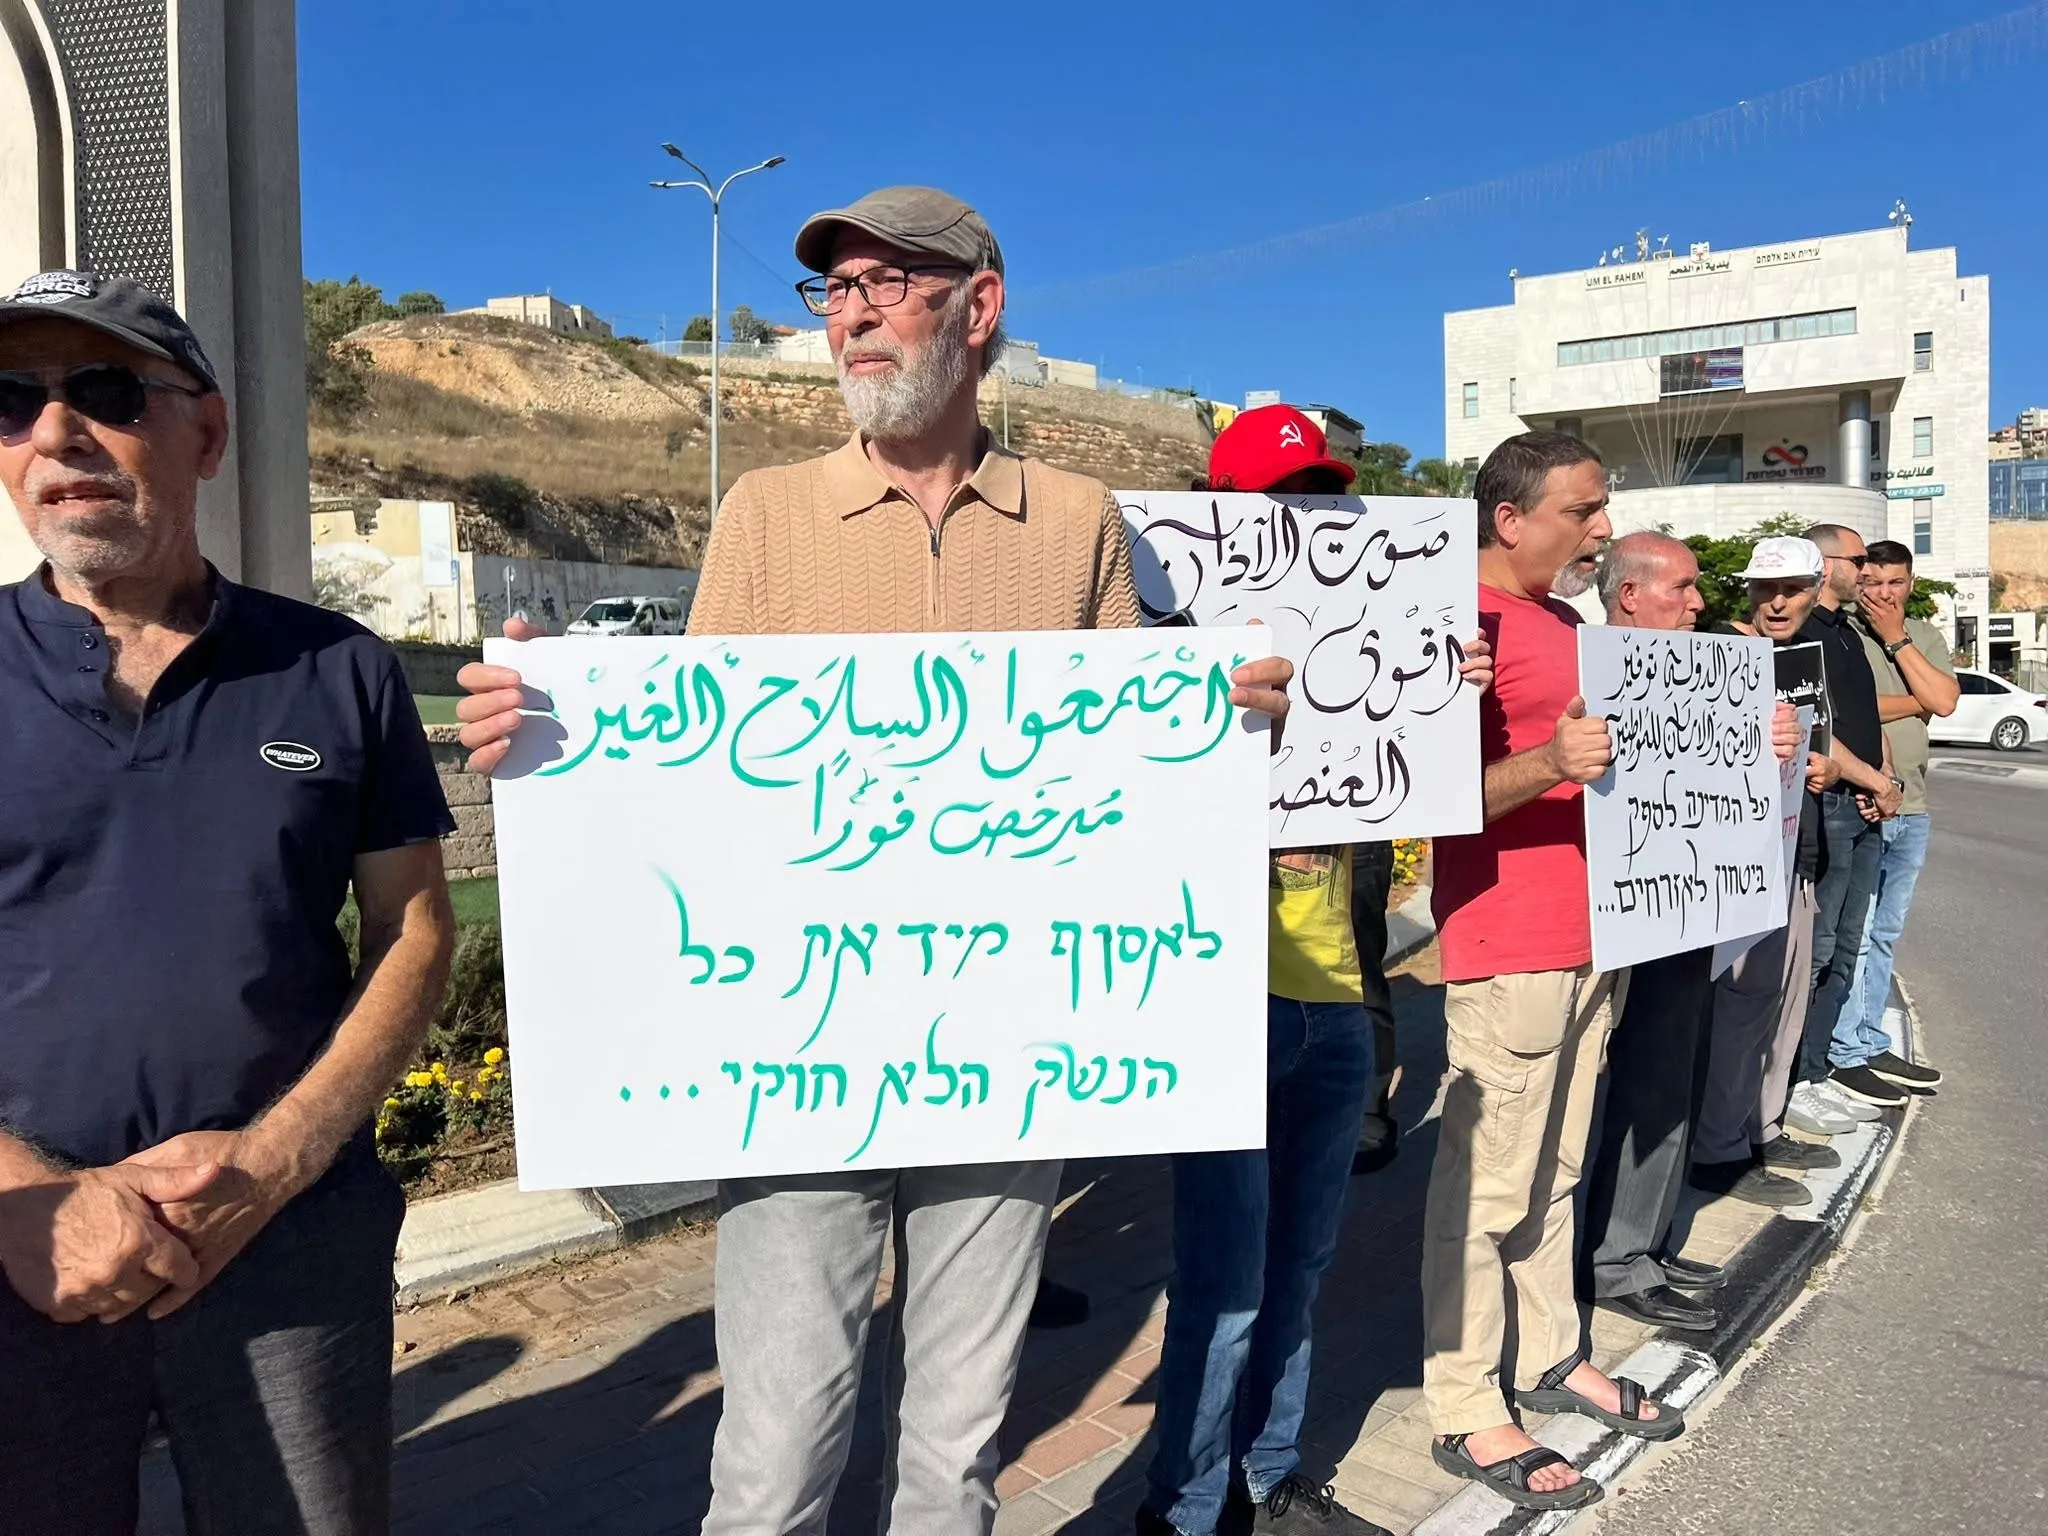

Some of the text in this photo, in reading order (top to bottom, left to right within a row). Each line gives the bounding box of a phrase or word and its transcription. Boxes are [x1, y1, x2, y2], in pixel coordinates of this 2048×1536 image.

[1586, 271, 1644, 287] UM EL FAHEM
[1783, 251, 1796, 260] אום
[1888, 488, 1914, 498] בריאו
[266, 748, 316, 762] WHATEVER
[1622, 769, 1677, 875] לספק
[1682, 790, 1743, 829] המדינה
[1743, 771, 1770, 822] על
[1715, 863, 1767, 933] ביטחון
[652, 866, 1223, 1053] לאסוף מיד את כל
[846, 1013, 991, 1163] הלא
[1019, 1042, 1179, 1139] הנשק
